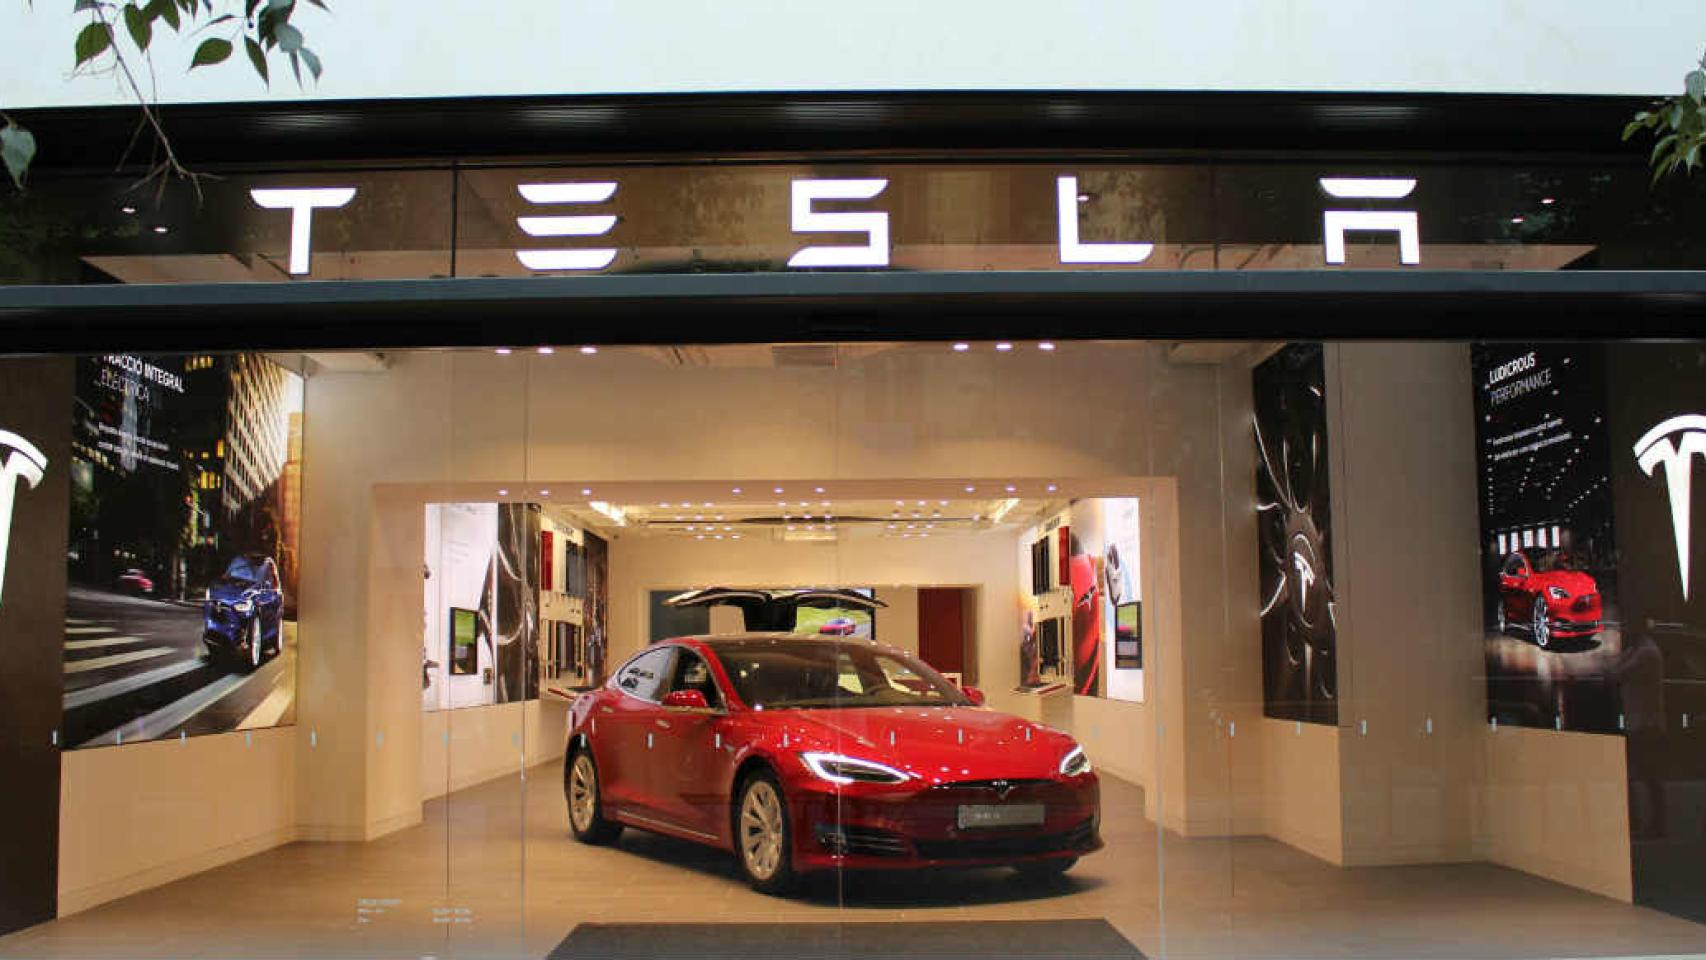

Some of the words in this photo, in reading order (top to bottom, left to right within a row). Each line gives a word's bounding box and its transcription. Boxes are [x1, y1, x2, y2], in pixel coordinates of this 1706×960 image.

[250, 176, 1420, 275] TESLA
[144, 362, 185, 393] INTEGRAL
[1489, 351, 1536, 384] LUDICROUS
[1490, 367, 1552, 406] PERFORMANCE
